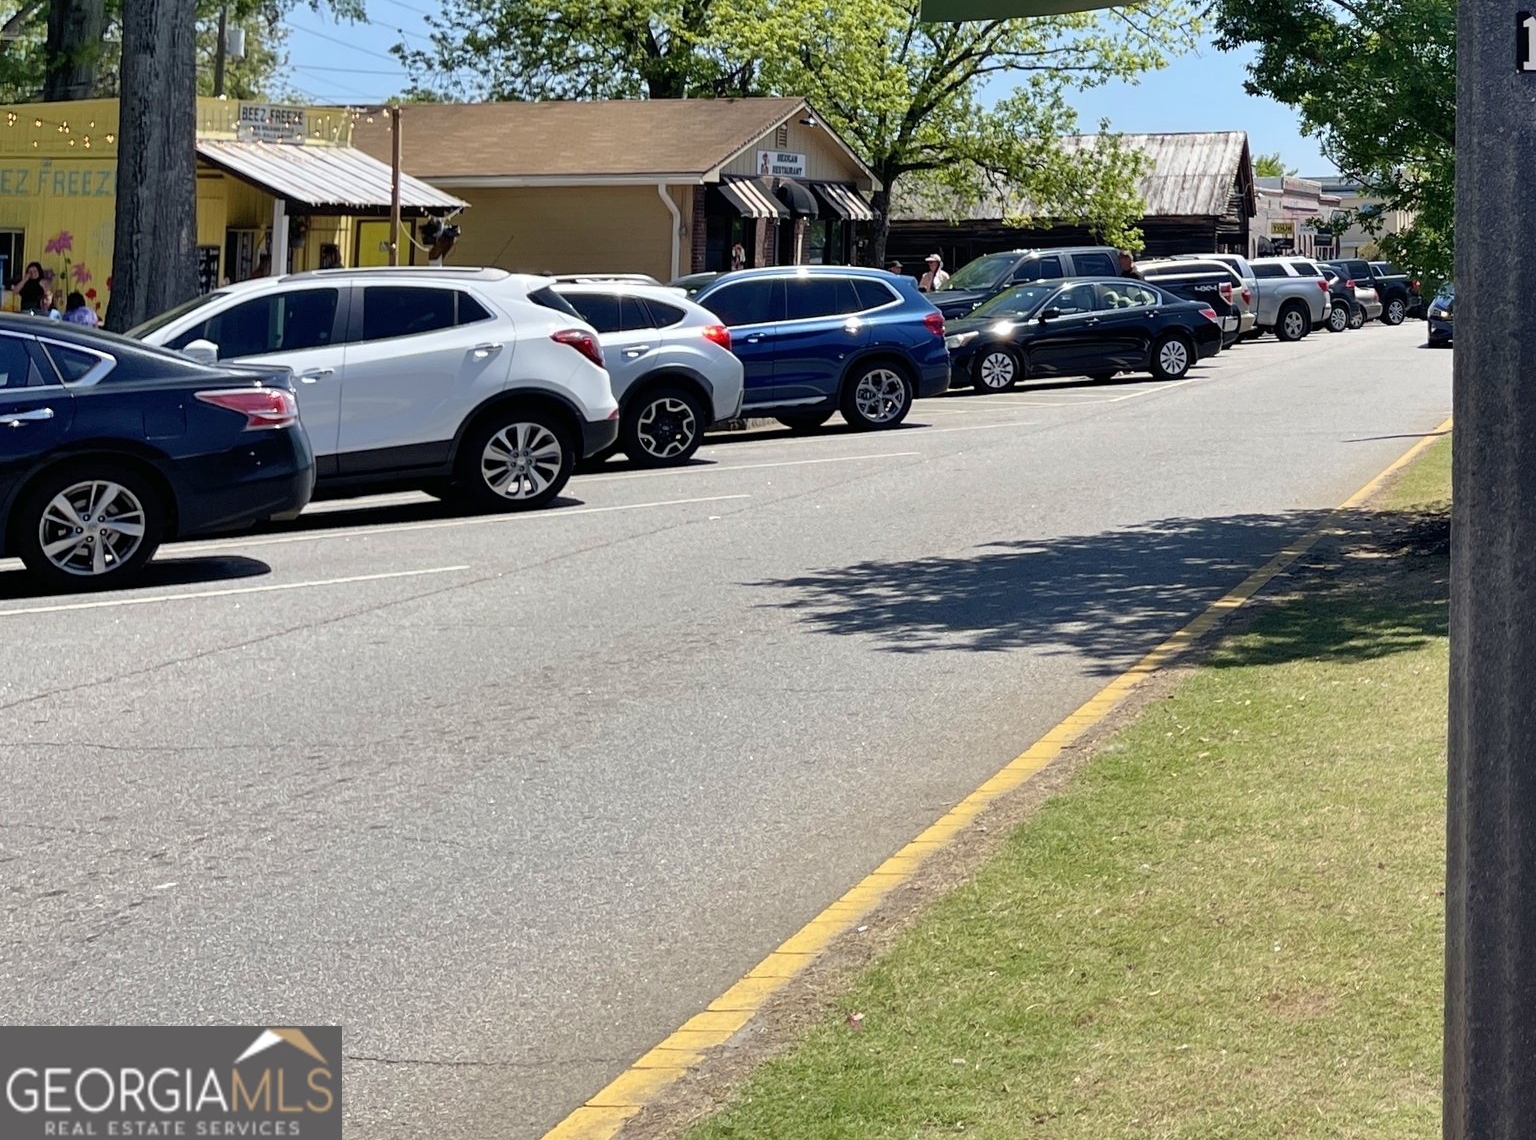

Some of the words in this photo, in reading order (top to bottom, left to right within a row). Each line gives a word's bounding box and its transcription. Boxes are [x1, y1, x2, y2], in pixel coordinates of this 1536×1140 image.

[242, 106, 266, 123] BEEZ
[270, 109, 304, 126] FREEZE
[772, 165, 803, 175] RESTAURANT
[38, 169, 118, 196] FREEZ
